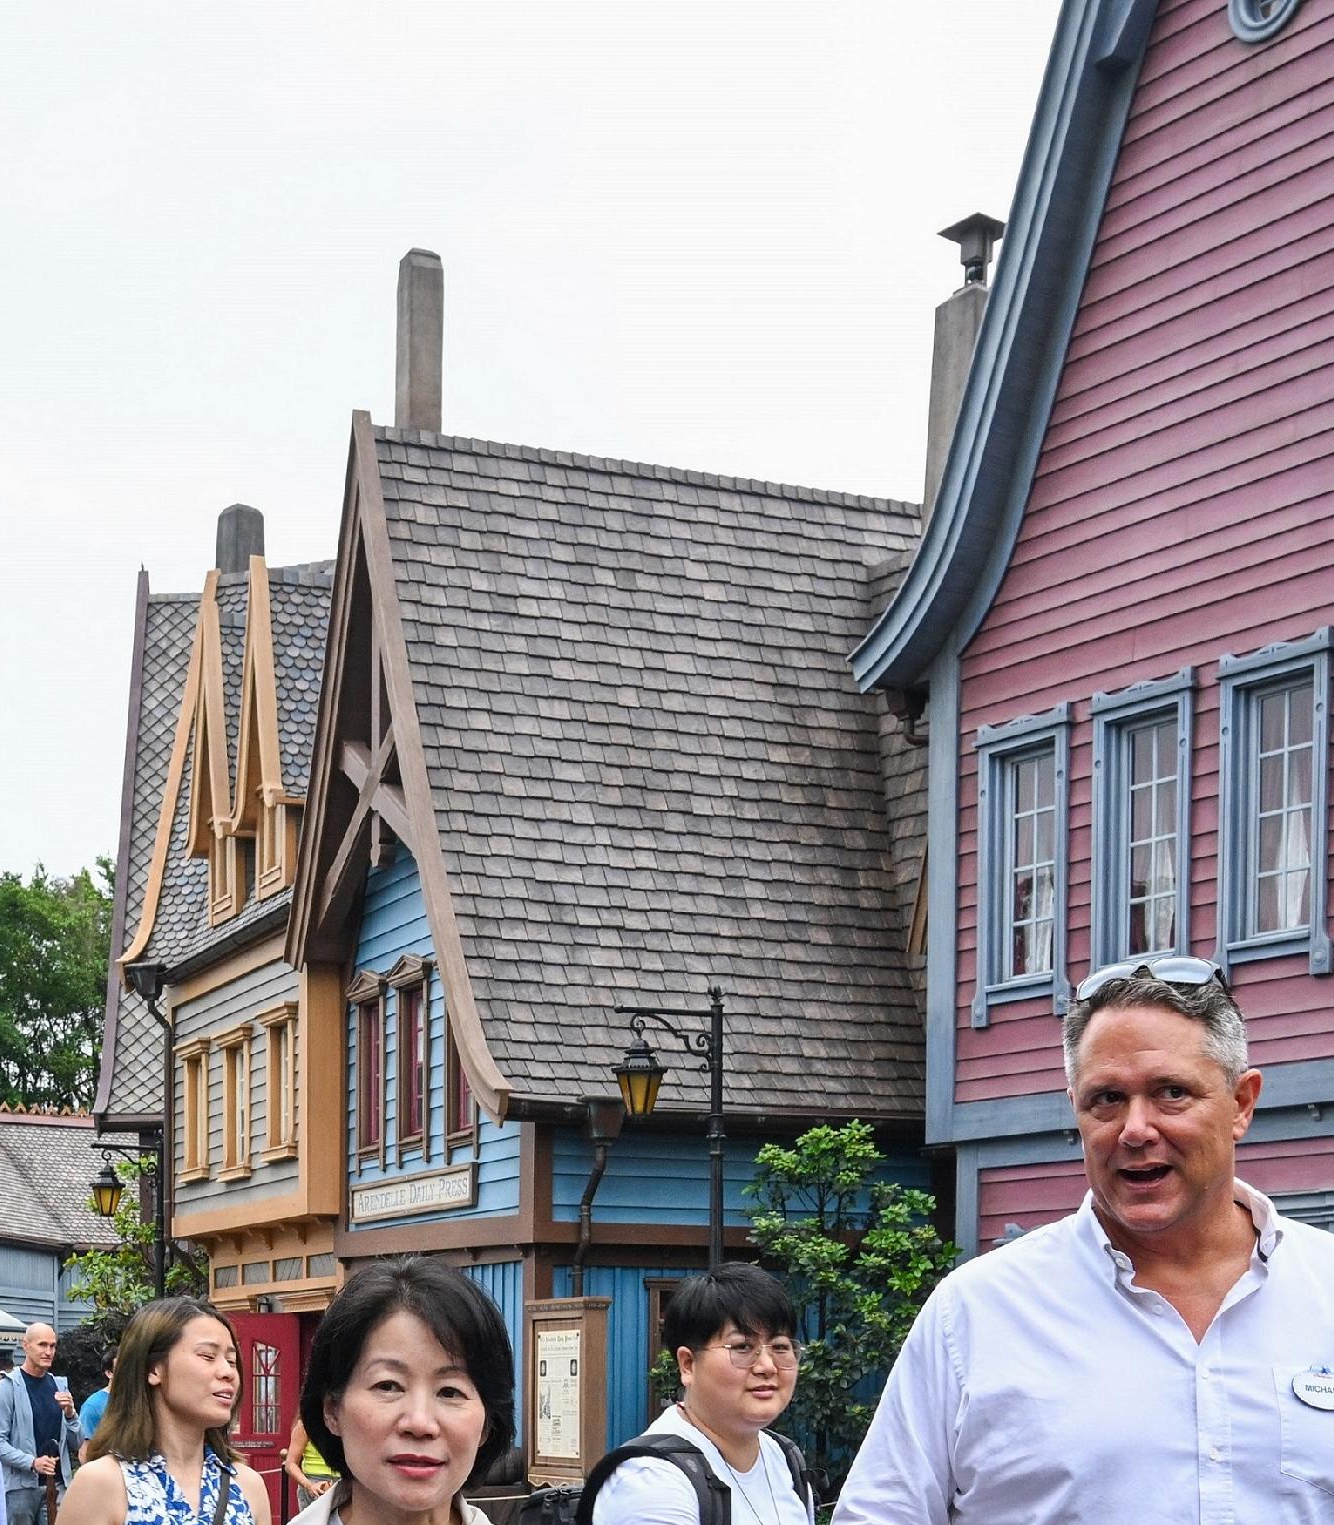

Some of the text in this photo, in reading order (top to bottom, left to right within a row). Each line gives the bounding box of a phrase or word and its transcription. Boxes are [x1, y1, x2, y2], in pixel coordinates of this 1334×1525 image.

[358, 1177, 468, 1213] ARENDELLE DAILY PRESS
